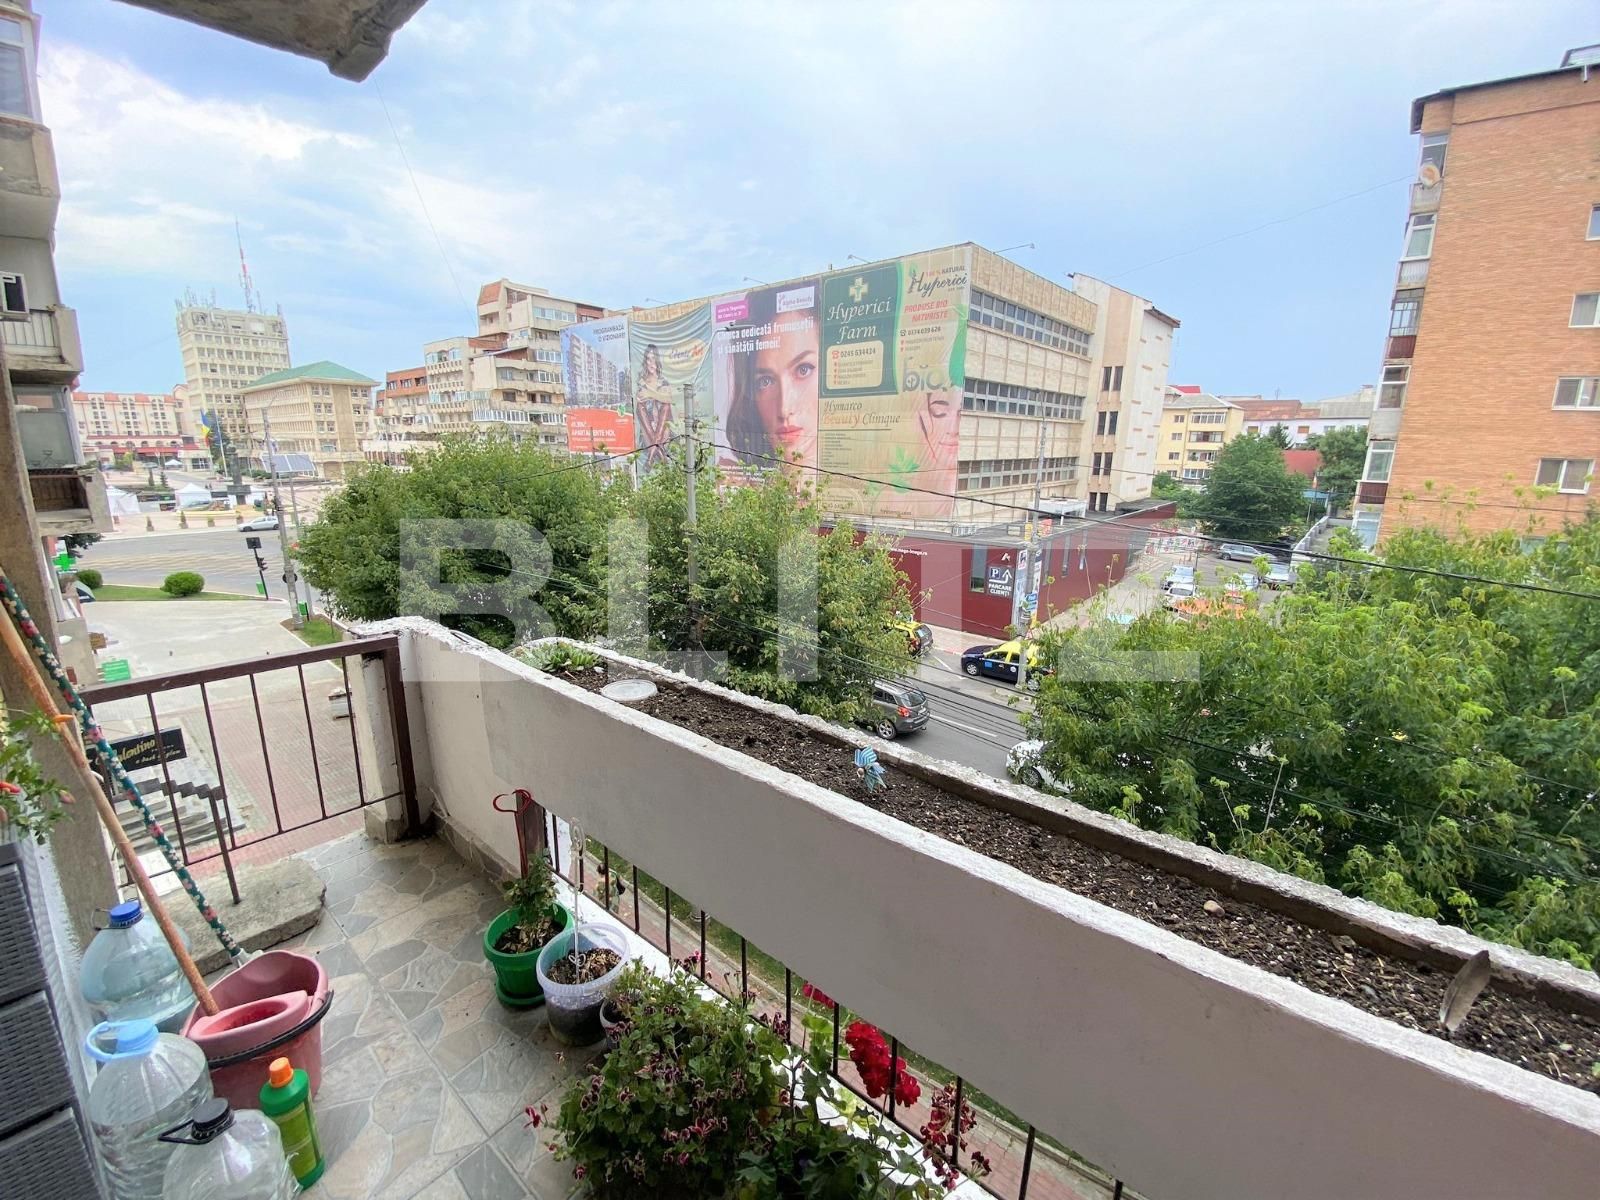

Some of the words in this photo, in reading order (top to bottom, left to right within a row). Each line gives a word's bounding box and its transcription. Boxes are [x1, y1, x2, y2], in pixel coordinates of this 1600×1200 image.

[908, 269, 968, 298] Hyperici
[827, 296, 891, 324] Hyperici
[936, 299, 949, 310] BIO
[741, 323, 772, 338] dedicată
[837, 324, 877, 344] Farm
[992, 569, 1000, 579] P
[988, 583, 1012, 592] PARCARE
